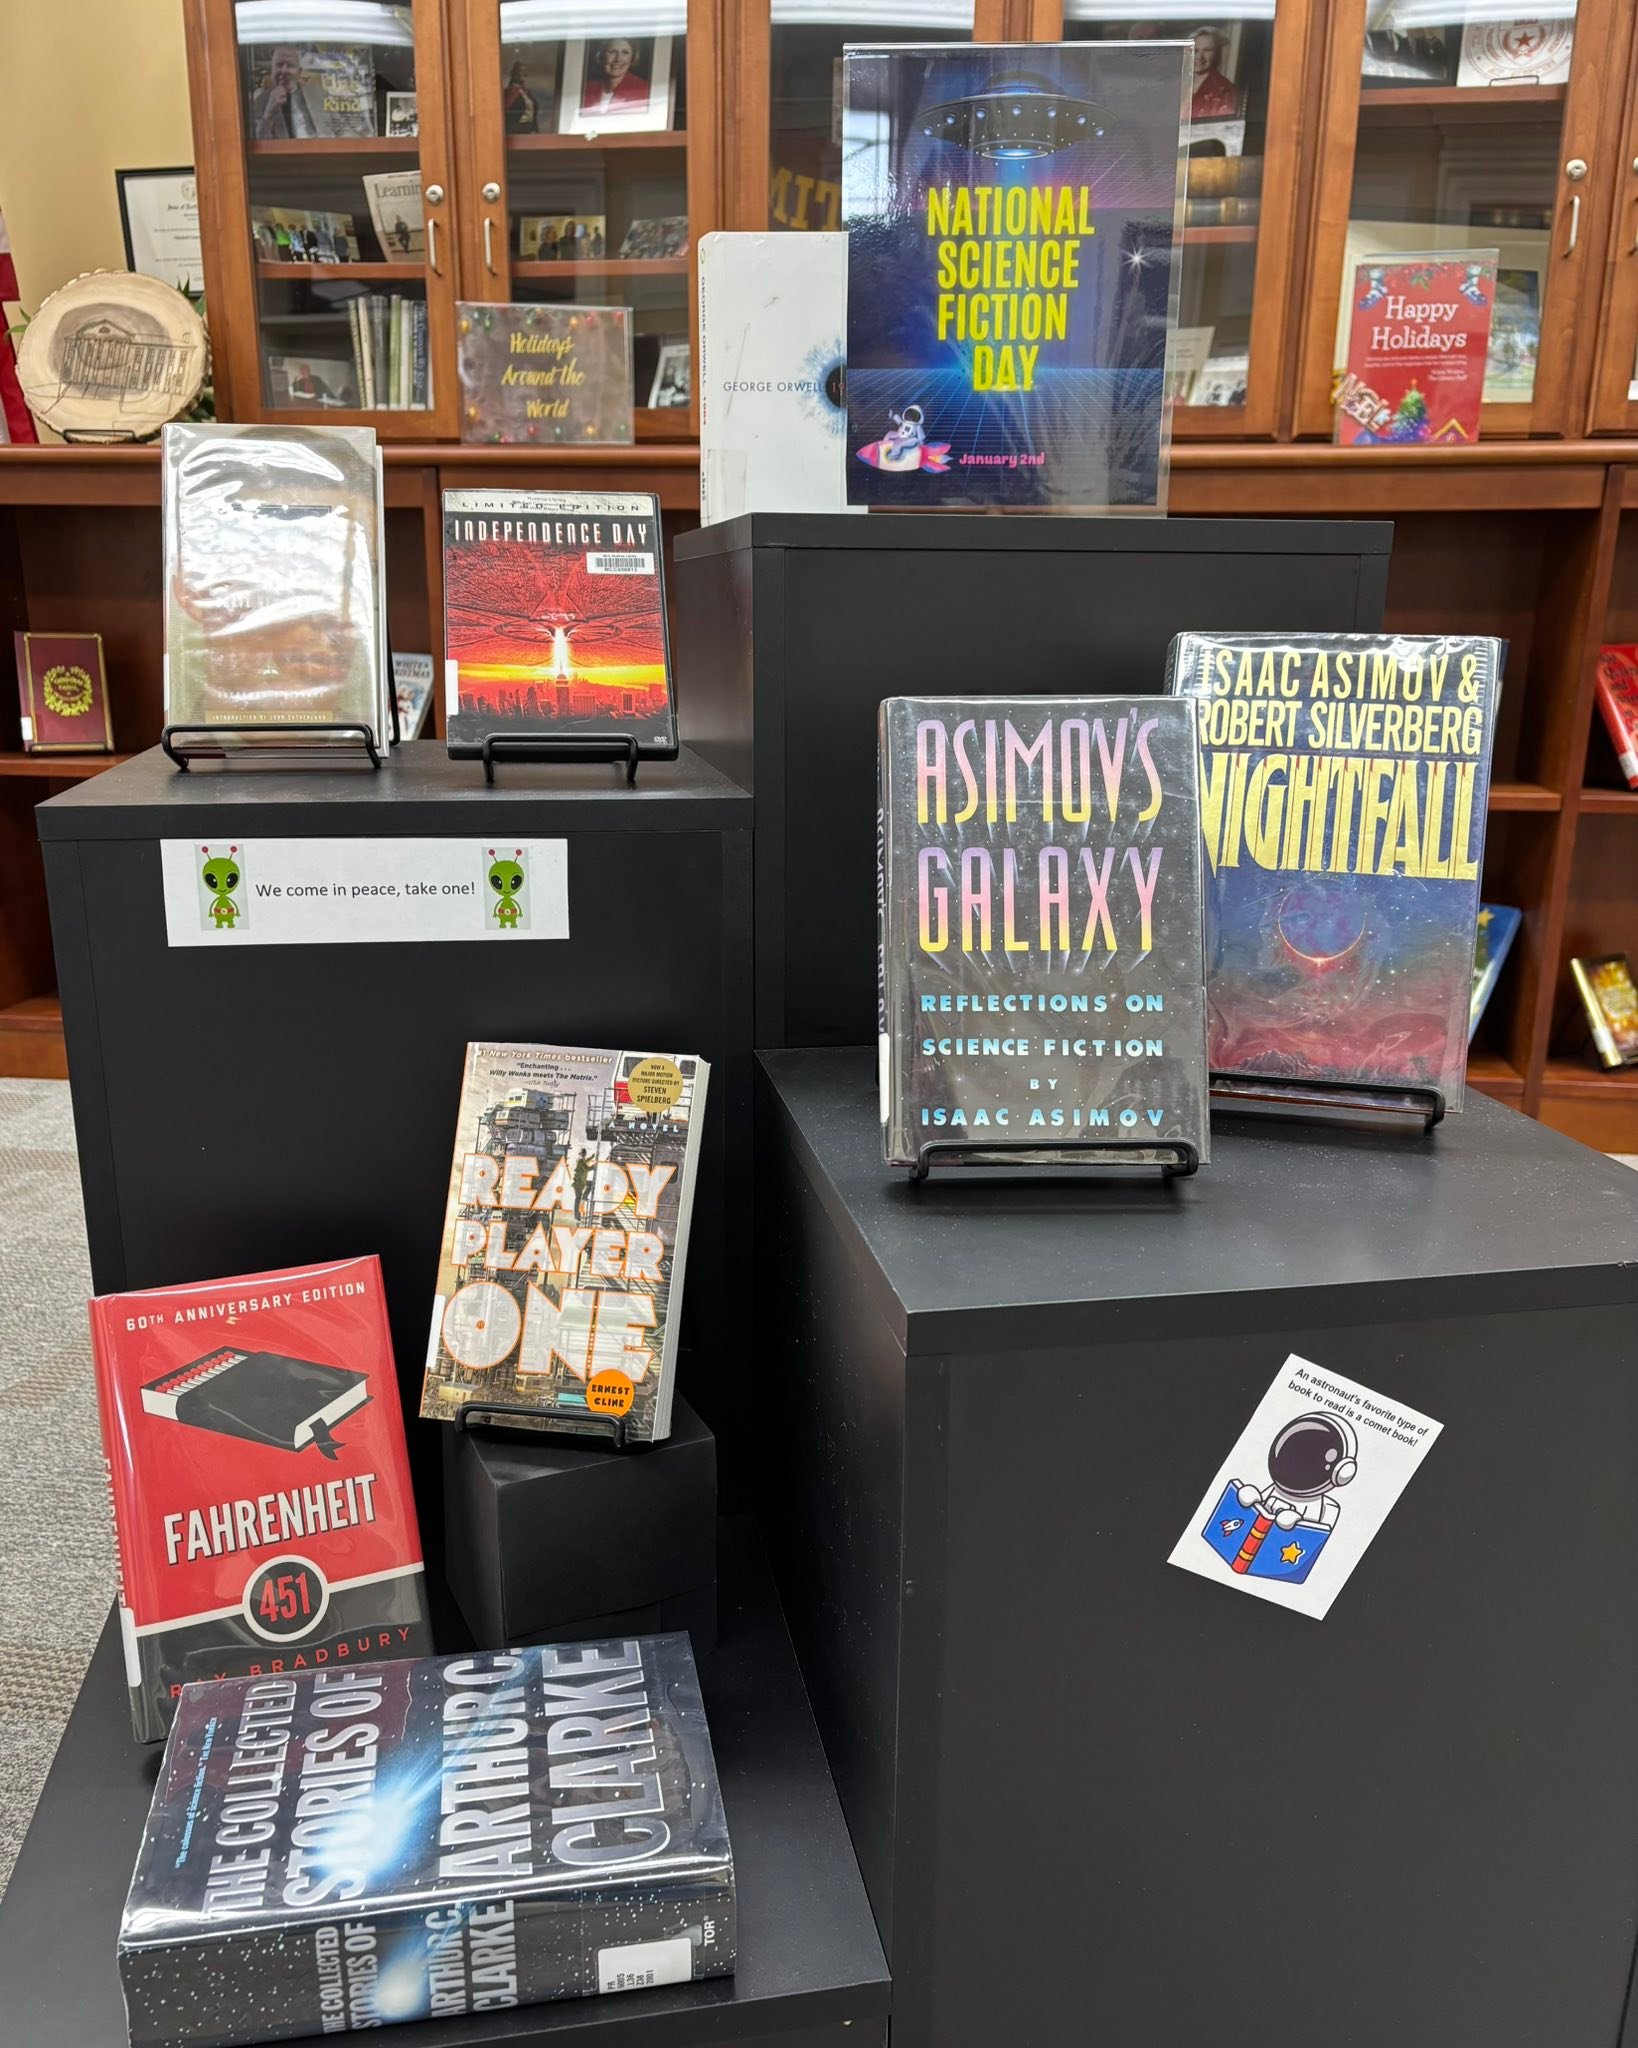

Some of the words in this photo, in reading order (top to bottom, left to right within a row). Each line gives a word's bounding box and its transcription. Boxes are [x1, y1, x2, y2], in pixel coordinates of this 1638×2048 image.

[927, 185, 1095, 236] NATIONAL
[937, 239, 1080, 289] SCIENCE
[937, 293, 1068, 340] FICTION
[1384, 295, 1459, 323] Happy
[509, 332, 575, 360] Holidays
[1371, 325, 1467, 352] Holidays
[501, 363, 555, 387] Around
[558, 357, 586, 387] the
[723, 381, 772, 392] GEORGE
[777, 381, 823, 392] ORWELL
[832, 382, 845, 393] 19
[972, 344, 1040, 392] DAY
[526, 399, 570, 419] World
[959, 453, 1018, 468] January
[1019, 452, 1045, 465] 2nd
[462, 502, 544, 510] LIMITED
[559, 503, 640, 511] EDITION
[455, 519, 601, 544] INDEPENDENCE
[612, 523, 647, 544] DAY
[1201, 649, 1301, 697] ISAAC
[1309, 650, 1449, 701] ASIMOV
[1457, 653, 1479, 703] &
[1200, 699, 1302, 747] ROBERT
[1308, 700, 1483, 755] SILVERBERG
[916, 706, 1164, 824] ASIMOV'S
[1200, 751, 1480, 880] NIGHTFALL
[256, 884, 282, 897] We
[286, 885, 328, 897] come
[333, 883, 346, 896] in
[352, 885, 401, 898] peace,
[405, 882, 437, 895] take
[441, 882, 475, 895] one!
[917, 846, 1164, 953] GALAXY
[921, 994, 1108, 1013] REFLECTIONS
[1126, 994, 1164, 1012] ON
[489, 1050, 509, 1058] New
[511, 1051, 531, 1059] York
[535, 1051, 562, 1060] Times
[565, 1053, 613, 1064] bestseller
[922, 1038, 1030, 1057] SCIENCE
[1043, 1039, 1164, 1057] FICTION
[489, 1069, 507, 1078] Willy
[508, 1070, 531, 1078] Wonka
[533, 1071, 554, 1079] meets
[643, 1086, 667, 1094] STEVEN
[1030, 1078, 1058, 1090] BY
[637, 1095, 671, 1104] SPIELBERG
[921, 1108, 1009, 1126] ISAAC
[1029, 1108, 1164, 1126] ASIMOV
[609, 1121, 615, 1129] A
[628, 1121, 679, 1133] NOVEL
[457, 1153, 676, 1219] READY
[451, 1218, 665, 1283] PLAYER
[127, 1313, 164, 1331] 60TH
[174, 1295, 291, 1323] ANNIVERSARY
[302, 1281, 366, 1303] EDITION
[442, 1281, 658, 1383] ONE
[591, 1384, 630, 1395] ERNEST
[594, 1397, 625, 1408] CLINE
[1295, 1368, 1310, 1381] An
[1310, 1375, 1360, 1405] astronaut's
[1362, 1400, 1396, 1422] favorite
[1397, 1416, 1416, 1431] type
[1417, 1428, 1430, 1437] of
[1288, 1380, 1313, 1398] book
[1313, 1392, 1323, 1403] to
[1324, 1398, 1347, 1414] read
[1345, 1407, 1355, 1418] is
[1363, 1417, 1392, 1435] comet
[1392, 1429, 1419, 1447] book!
[163, 1473, 377, 1565] FAHRENHEIT
[259, 1571, 311, 1623] 451
[170, 1671, 227, 1699] RY
[250, 1626, 411, 1677] BRADBURY
[443, 1648, 524, 1685] C.
[309, 1673, 383, 1719] OF
[216, 1680, 297, 1846] COLLECTED
[541, 1641, 671, 1867] CLARKE
[439, 1687, 533, 1877] ARTHUR
[282, 1722, 380, 1907] STORIES
[202, 1848, 271, 1920] THE
[344, 1923, 377, 1952] OF
[469, 1900, 518, 2011] CLARKE
[315, 1926, 344, 2011] COLLECTED
[346, 1950, 382, 2029] STORIES
[427, 1931, 466, 2017] ARTHUR
[322, 2012, 346, 2033] THE
